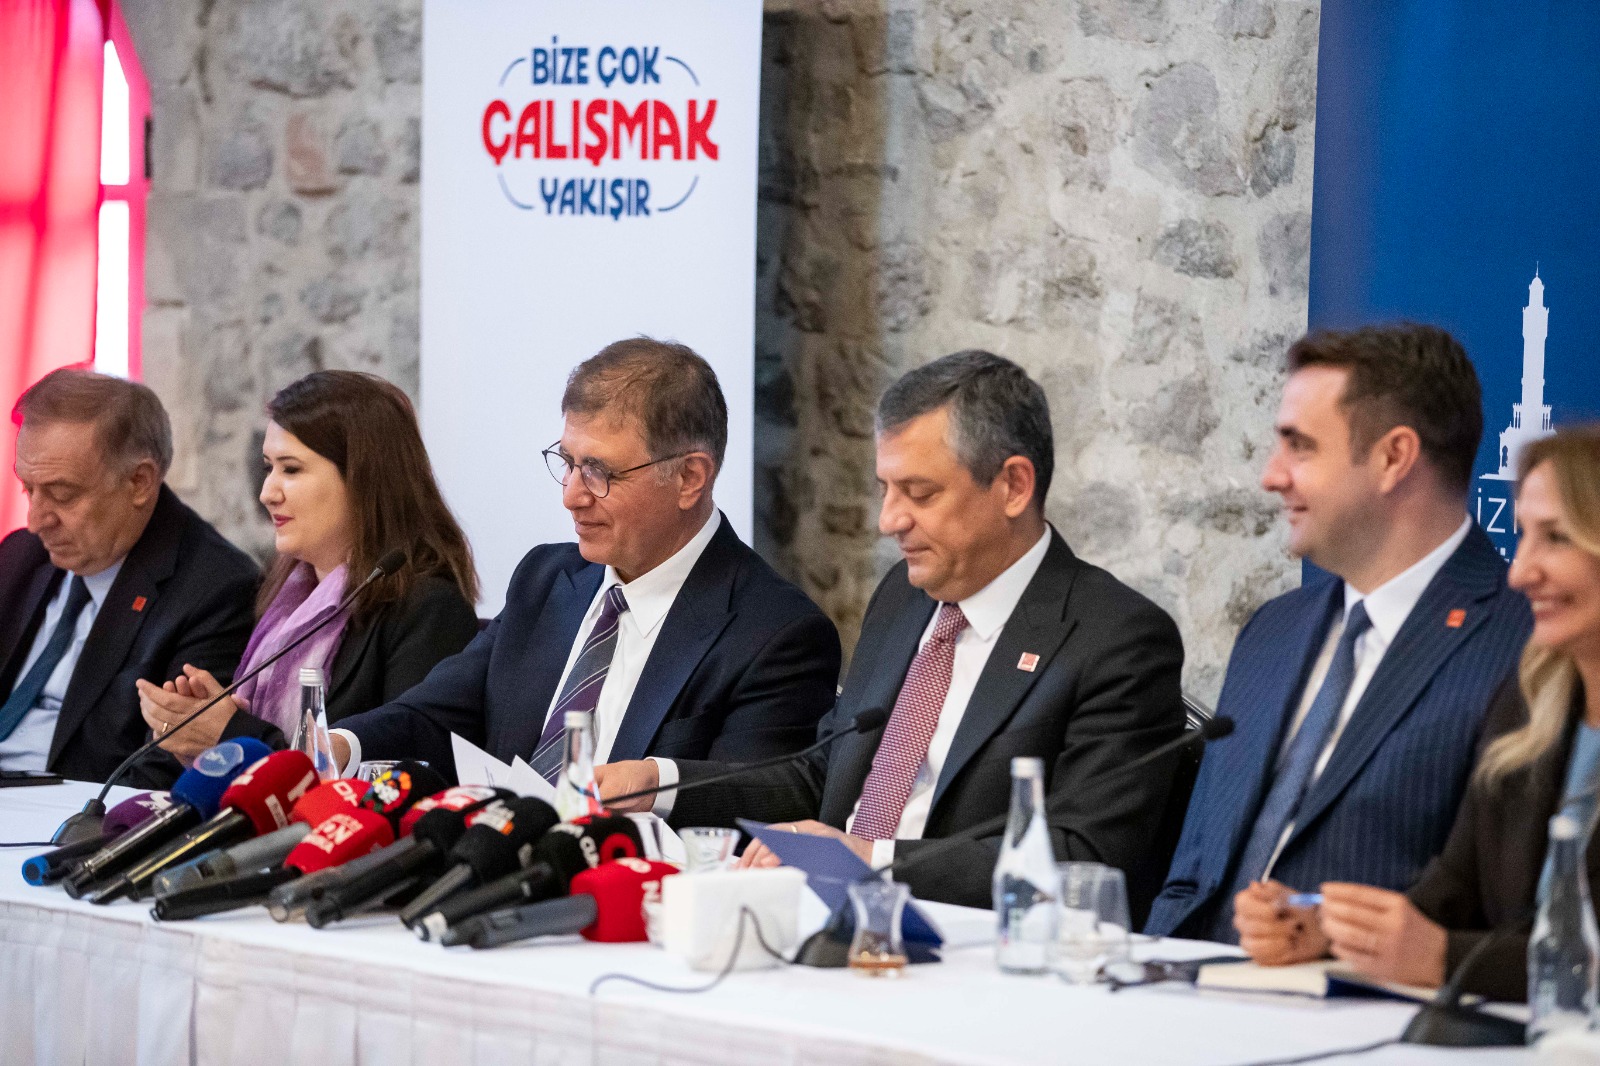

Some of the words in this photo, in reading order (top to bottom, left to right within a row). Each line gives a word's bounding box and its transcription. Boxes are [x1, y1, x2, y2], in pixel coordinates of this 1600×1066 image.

[532, 35, 589, 84] BİZE
[597, 46, 660, 87] ÇOK
[482, 98, 719, 166] ÇALIŞMAK
[540, 177, 650, 221] YAKIŞIR
[1477, 487, 1518, 534] İZ
